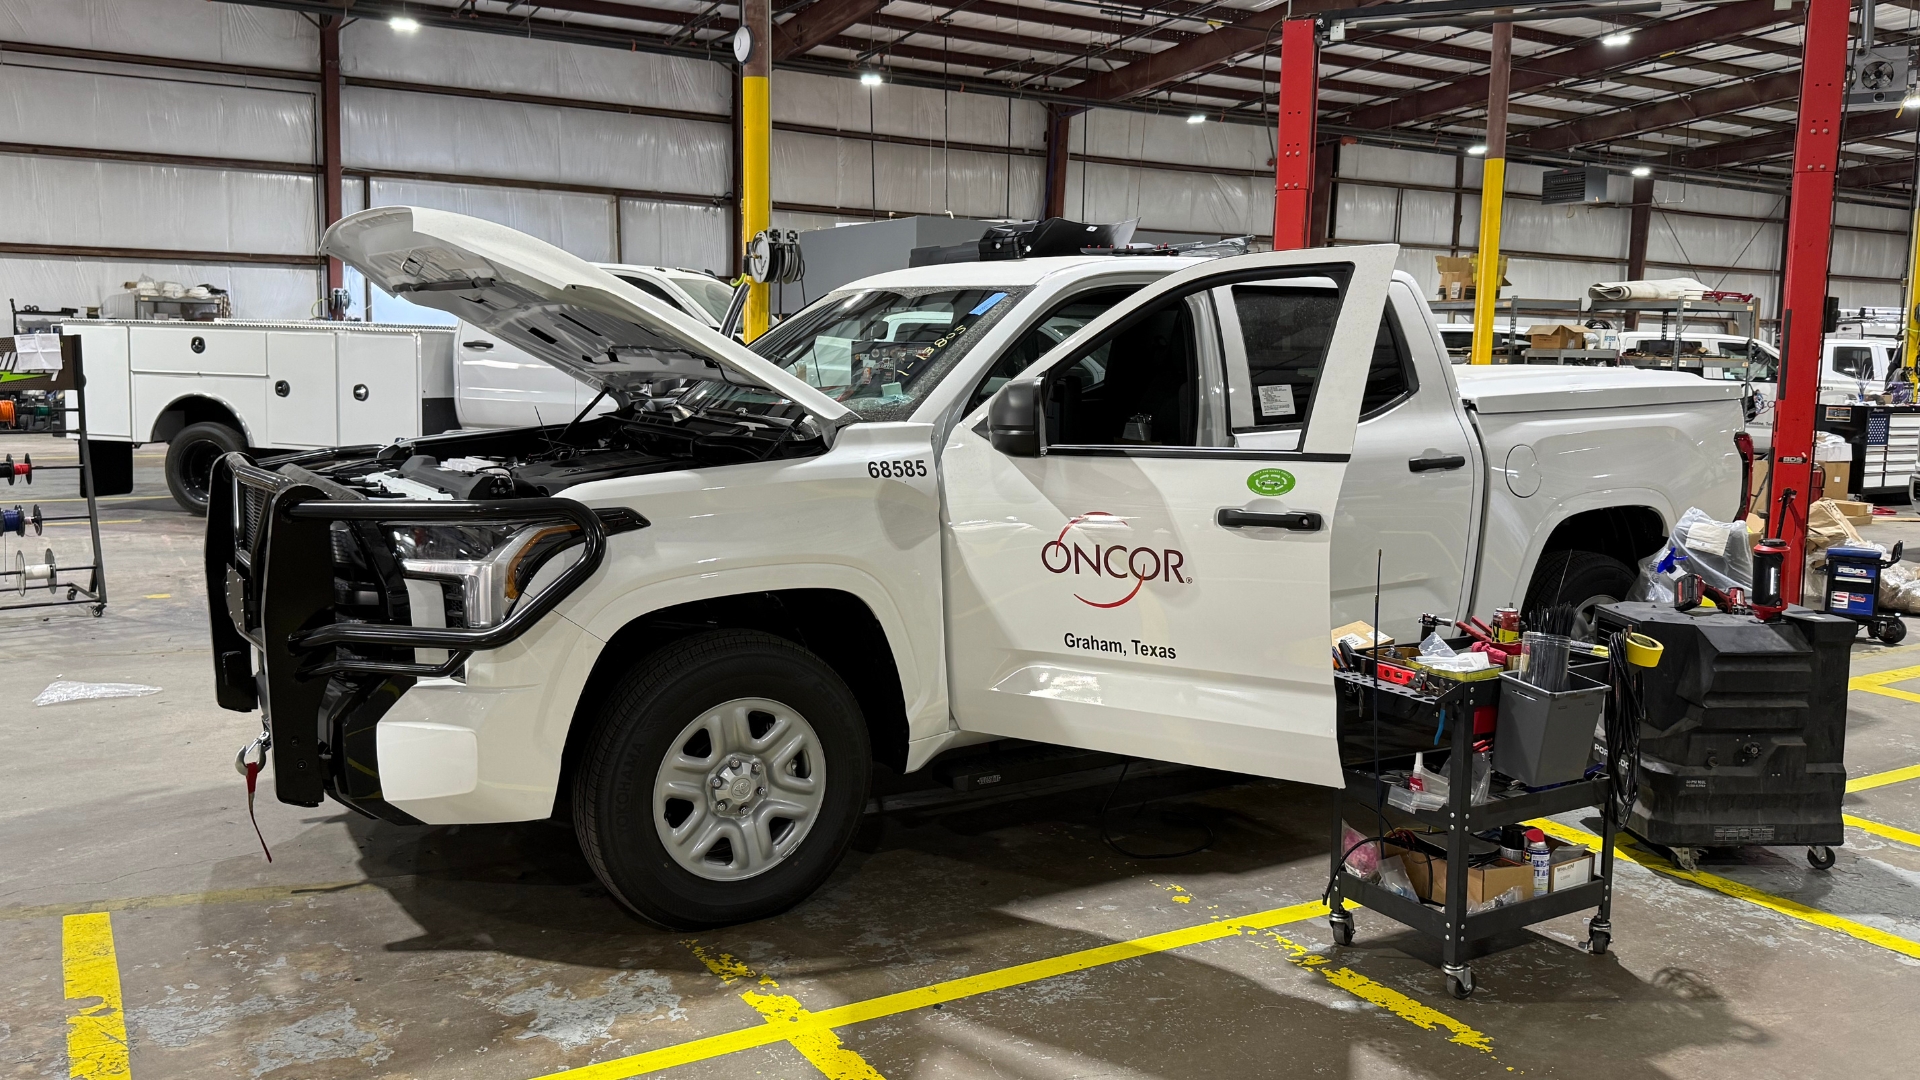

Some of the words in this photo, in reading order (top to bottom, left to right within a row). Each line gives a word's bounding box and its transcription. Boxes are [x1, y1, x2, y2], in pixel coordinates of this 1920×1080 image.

[867, 459, 928, 479] 68585
[1064, 631, 1127, 657] Graham,
[1131, 639, 1177, 660] Texas
